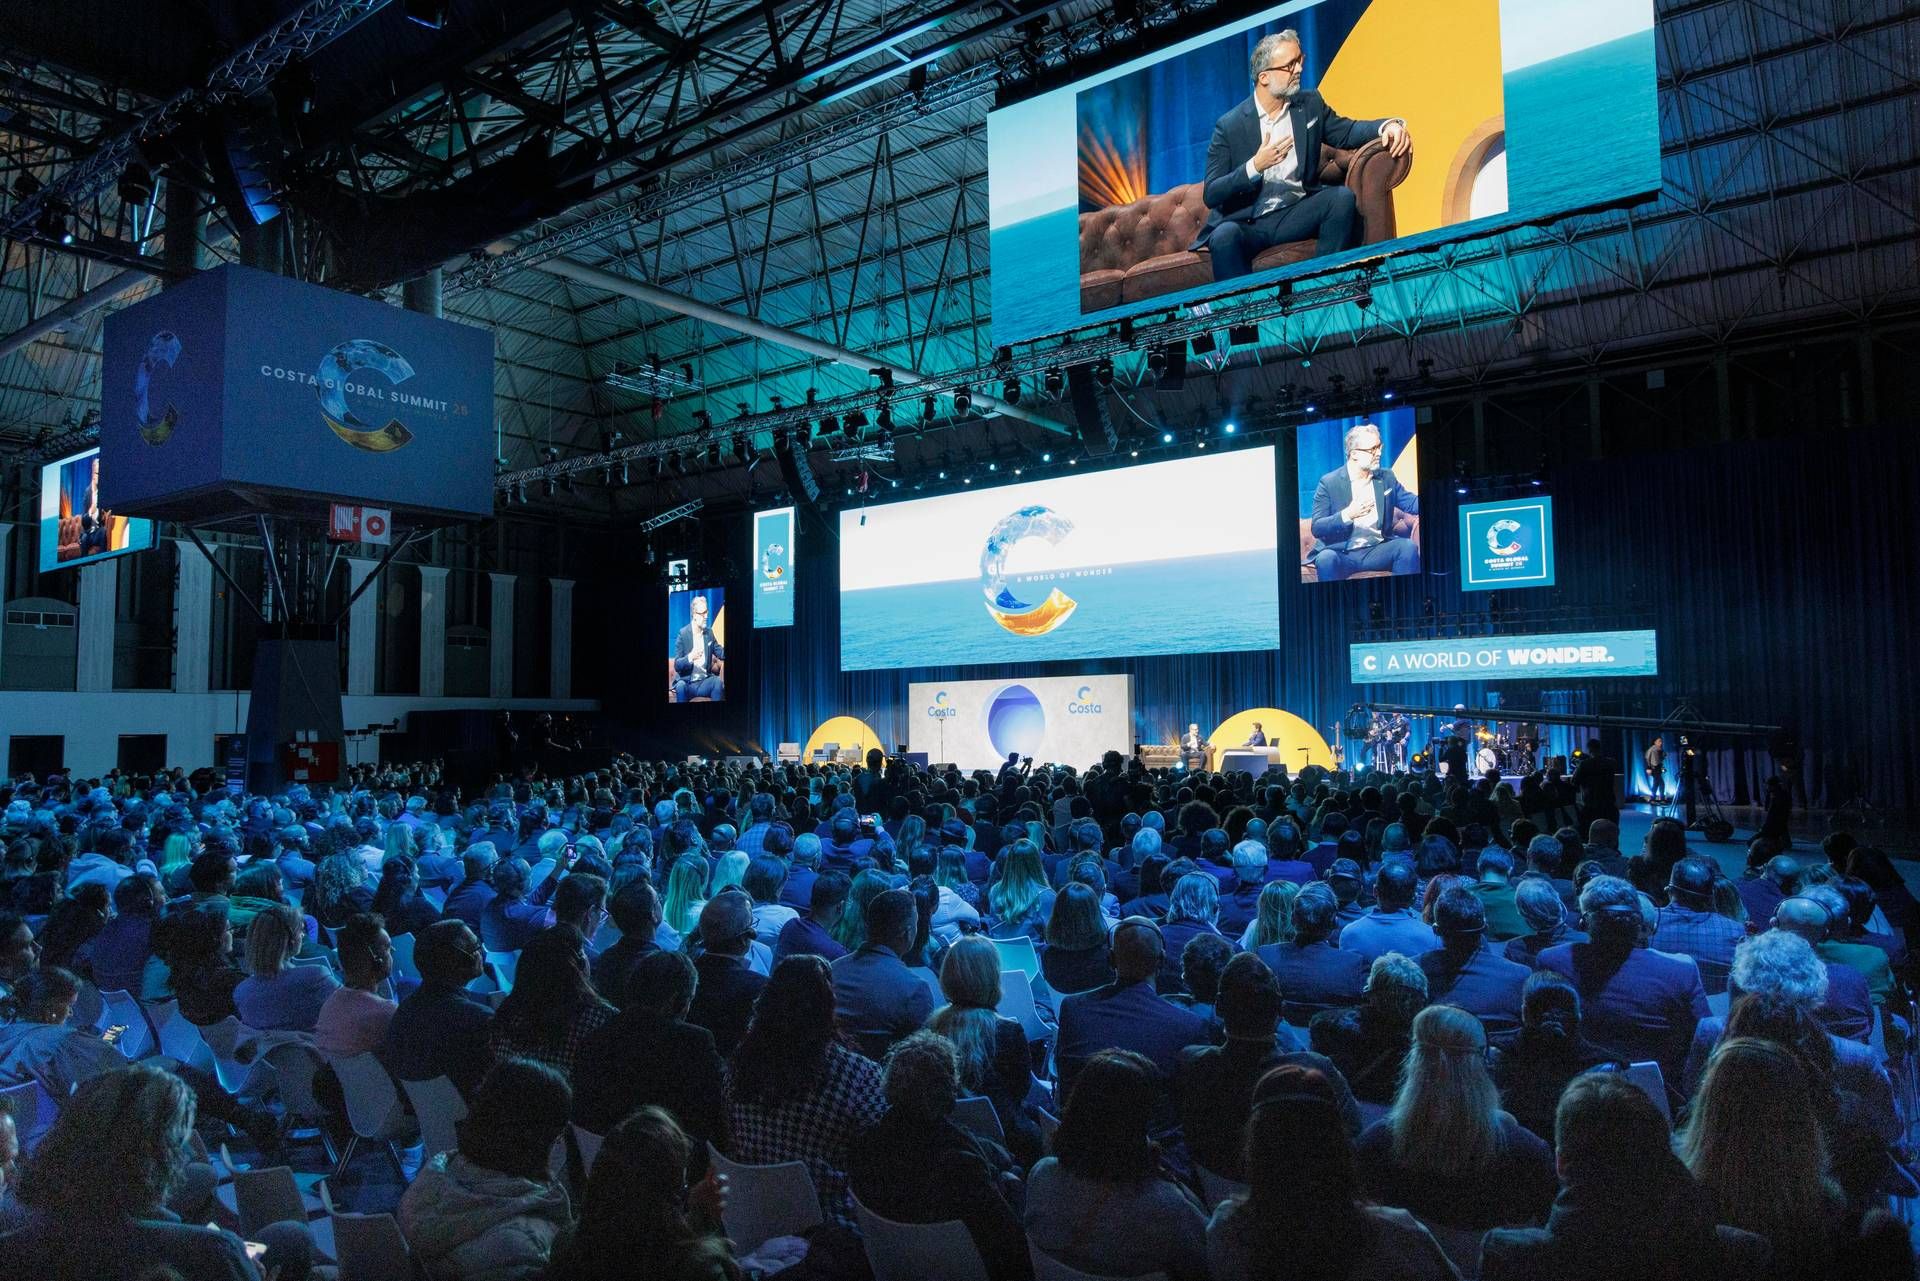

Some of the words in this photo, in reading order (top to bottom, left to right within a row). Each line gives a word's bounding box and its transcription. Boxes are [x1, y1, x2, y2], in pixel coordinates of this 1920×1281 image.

[261, 365, 319, 387] COSTA
[324, 378, 385, 401] GLOBAL
[390, 390, 448, 412] SUMMIT
[1363, 655, 1377, 671] C
[1387, 654, 1400, 670] A
[1404, 651, 1471, 669] WORLD
[1476, 649, 1503, 667] OF
[1508, 646, 1615, 666] WONDER.
[927, 706, 956, 717] Costa
[1068, 702, 1102, 714] Costa
